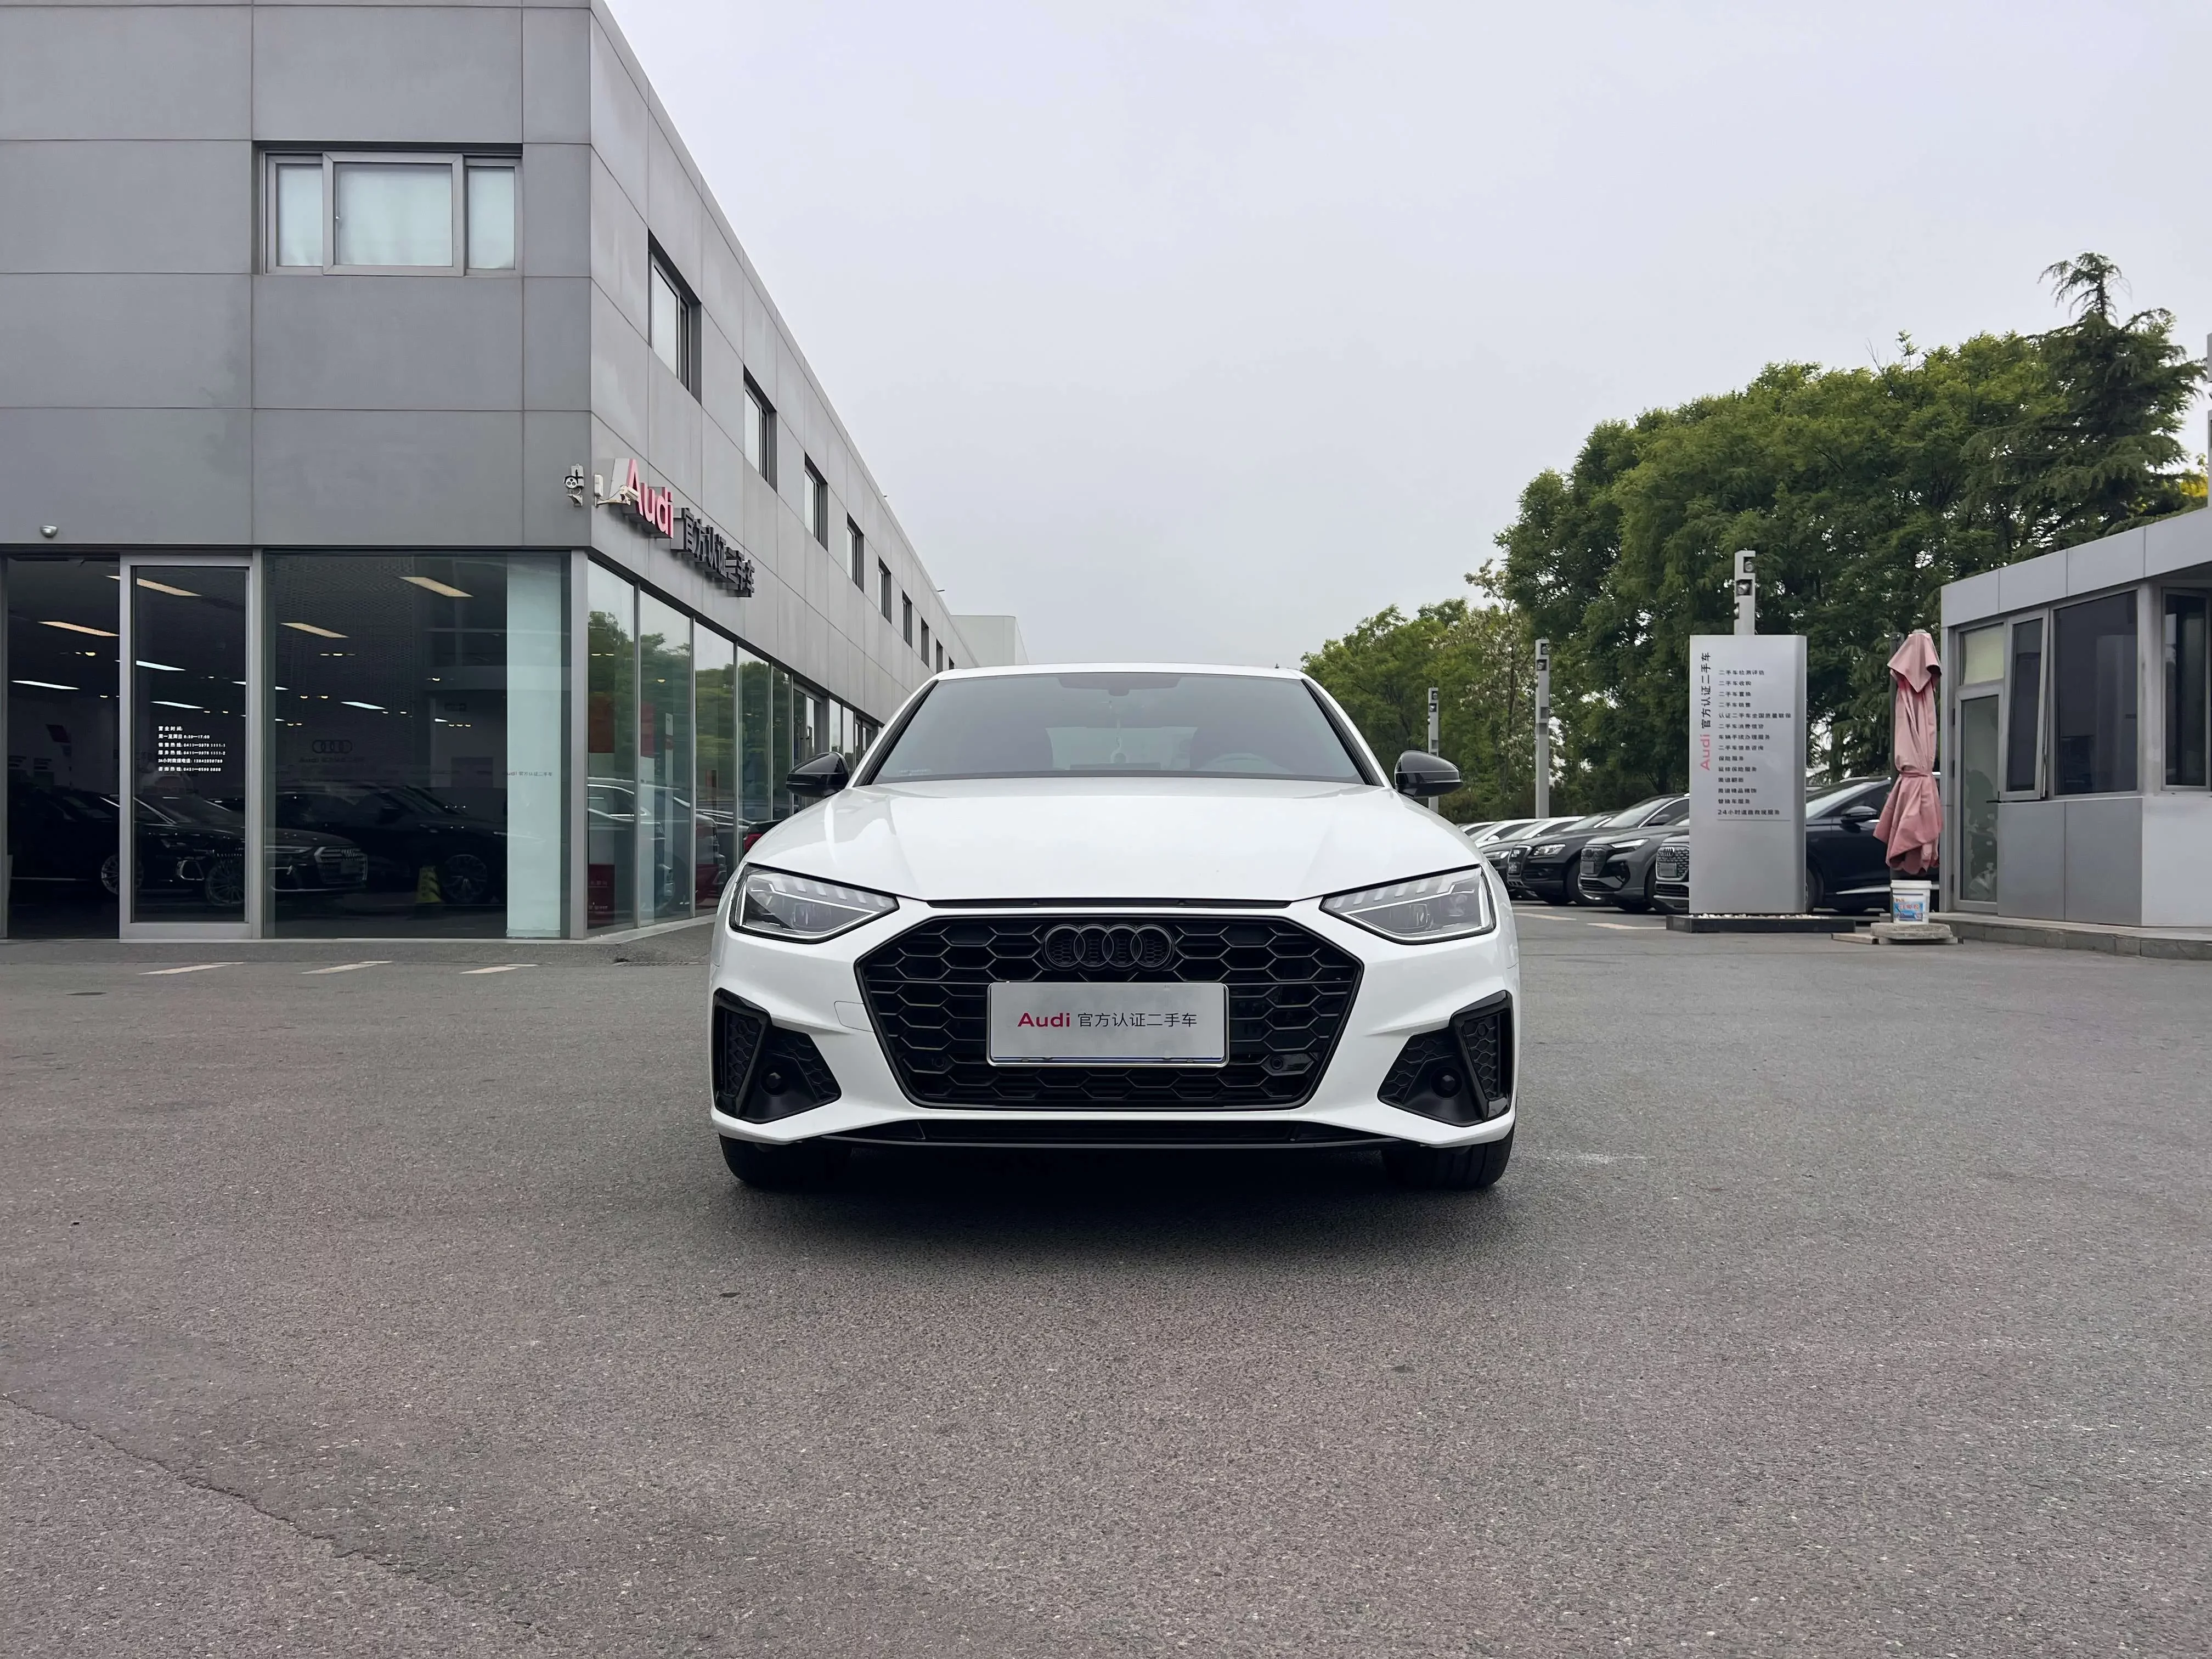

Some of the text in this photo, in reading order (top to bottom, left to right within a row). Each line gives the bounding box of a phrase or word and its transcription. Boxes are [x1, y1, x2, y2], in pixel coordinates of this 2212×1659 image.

[626, 459, 674, 538] Audi
[1700, 652, 1711, 770] Audi 官方认证二手车
[1018, 1012, 1198, 1028] Audi 官方认证二手车
